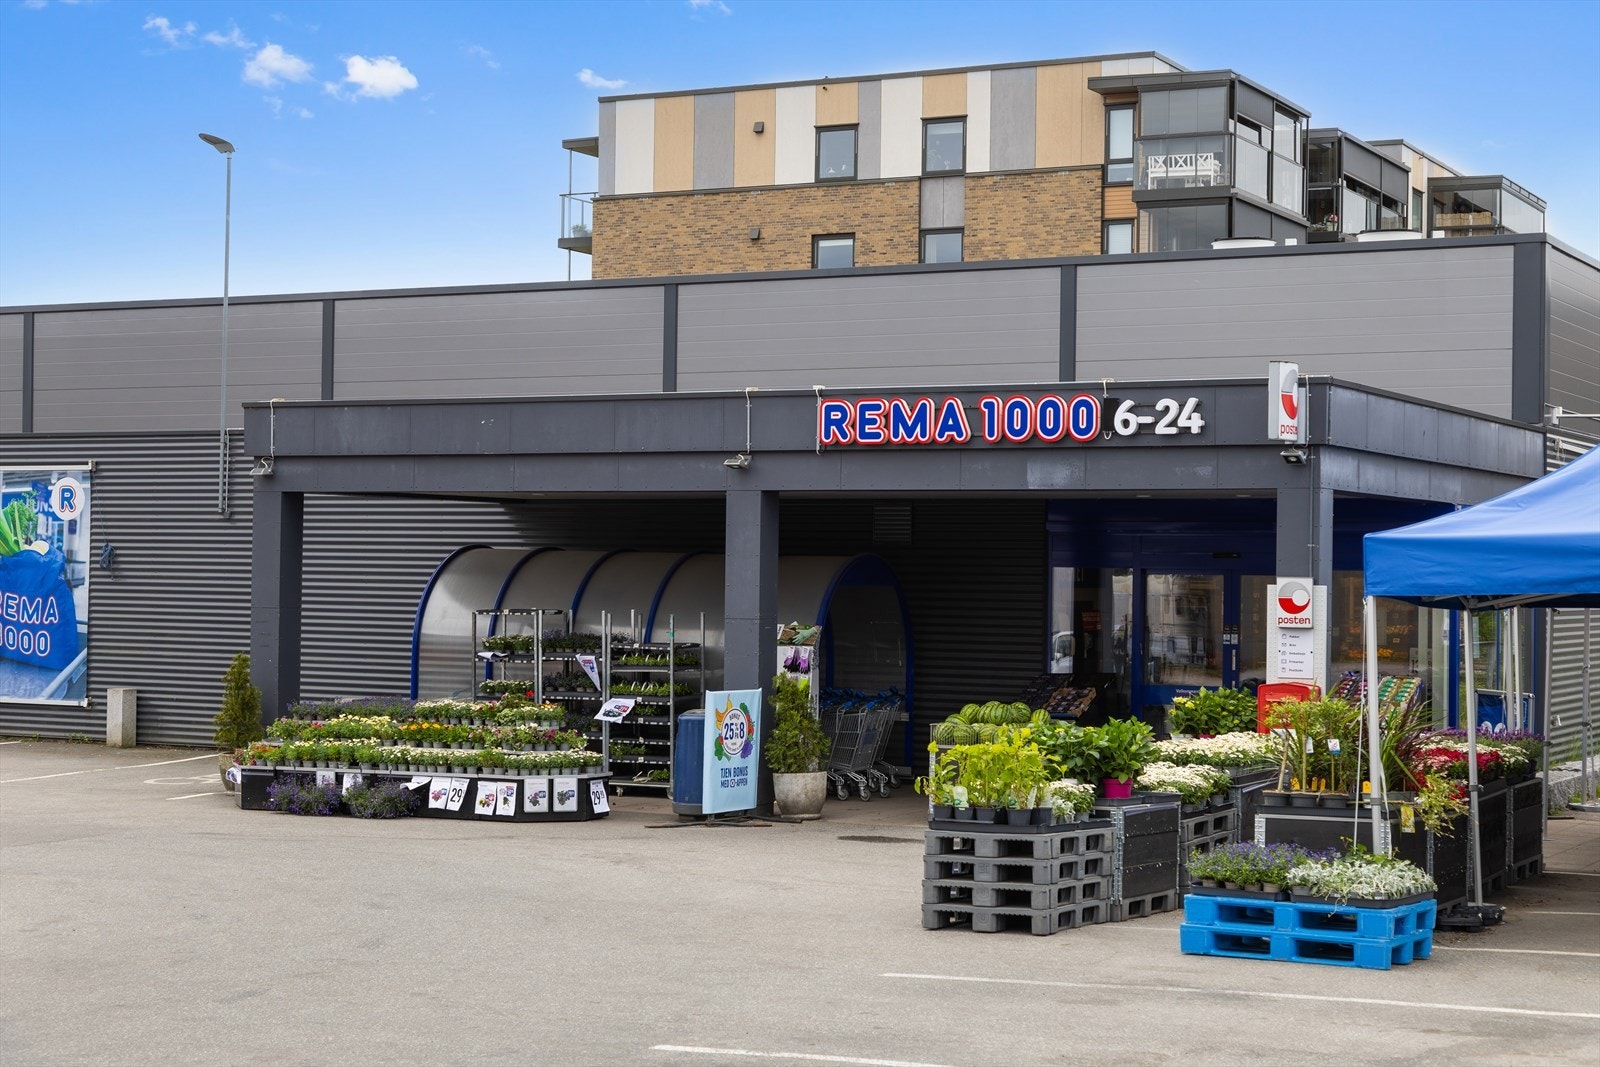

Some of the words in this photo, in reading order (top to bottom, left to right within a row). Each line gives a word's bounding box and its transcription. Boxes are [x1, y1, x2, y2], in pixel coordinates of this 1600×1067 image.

[819, 395, 971, 445] REMA
[980, 394, 1102, 442] 1000
[1114, 397, 1206, 436] 6-24
[0, 591, 59, 625] EMA
[1278, 616, 1310, 624] posten
[0, 622, 50, 657] 000
[724, 722, 734, 740] 25
[739, 721, 745, 739] 8
[720, 767, 732, 779] TJEN
[733, 766, 748, 778] BONUS
[720, 779, 729, 788] MED
[450, 788, 463, 803] 29
[592, 790, 601, 806] 29
